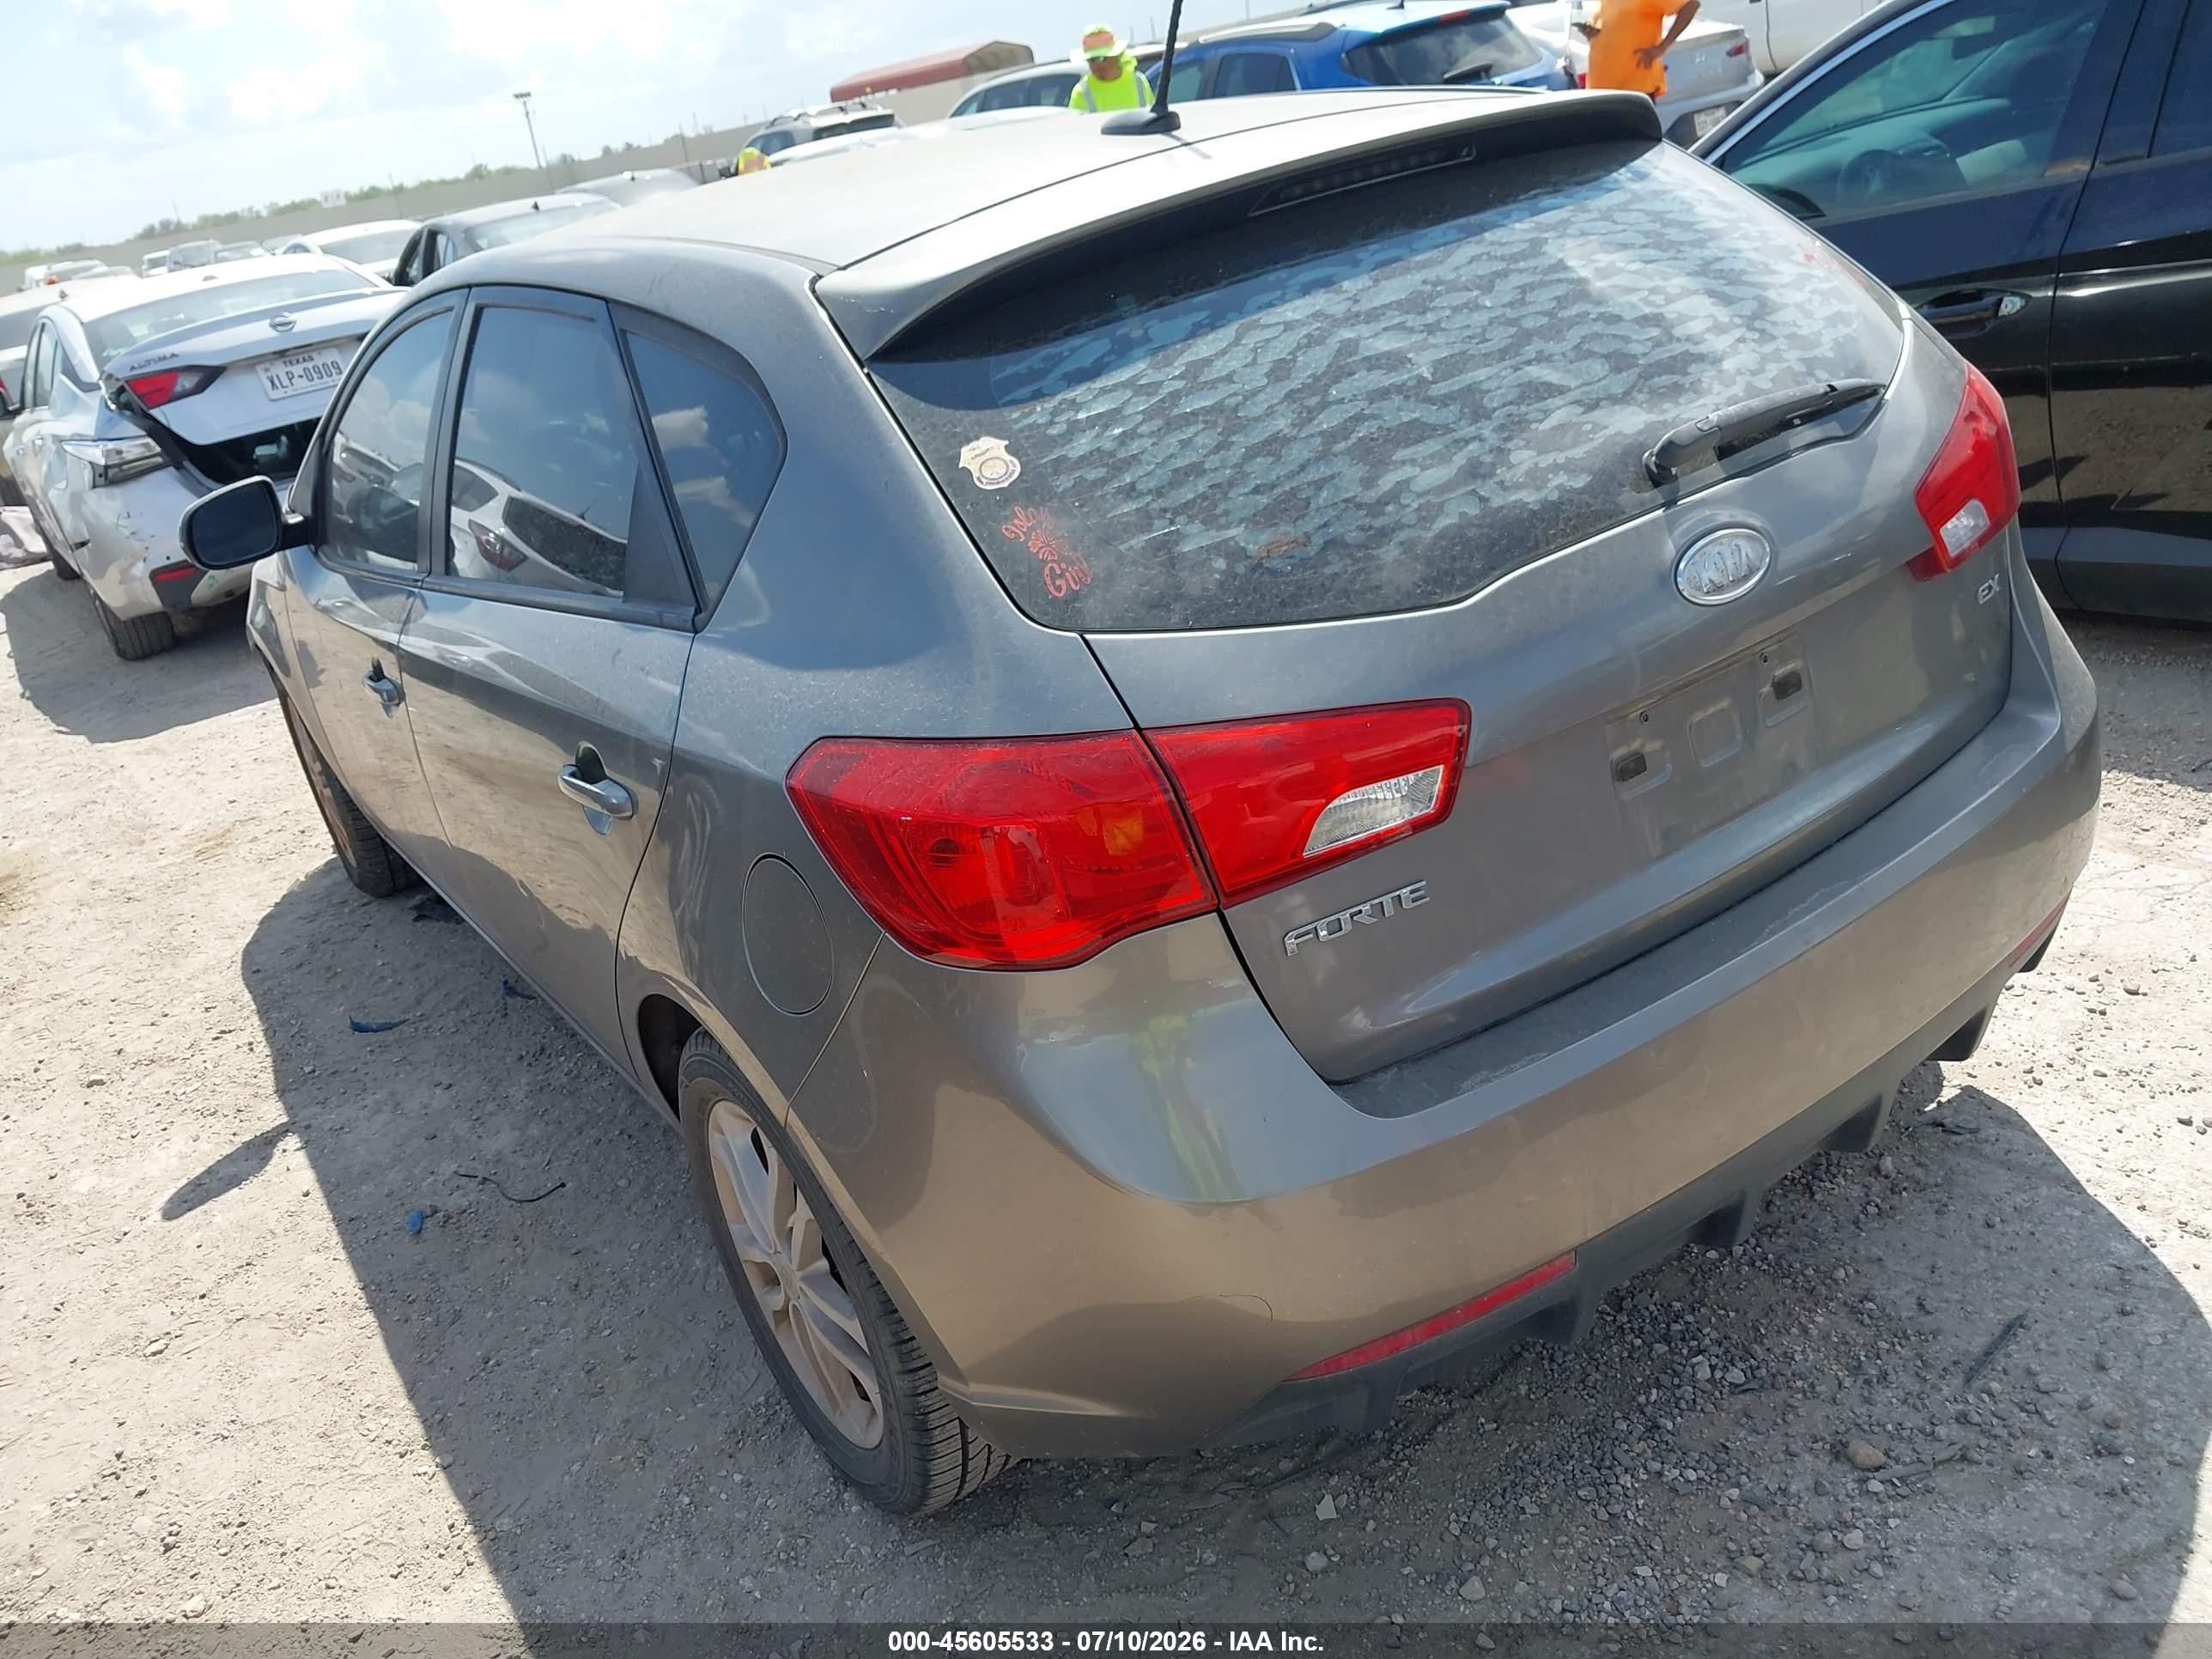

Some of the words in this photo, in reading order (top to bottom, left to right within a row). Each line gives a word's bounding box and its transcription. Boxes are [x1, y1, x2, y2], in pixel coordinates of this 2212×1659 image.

[130, 352, 179, 371] ALTIMA
[266, 360, 343, 391] XLP-0909
[283, 355, 314, 368] TEXAS
[1689, 539, 1761, 594] KIA
[1978, 574, 1999, 605] EX
[1284, 879, 1431, 957] FORTE
